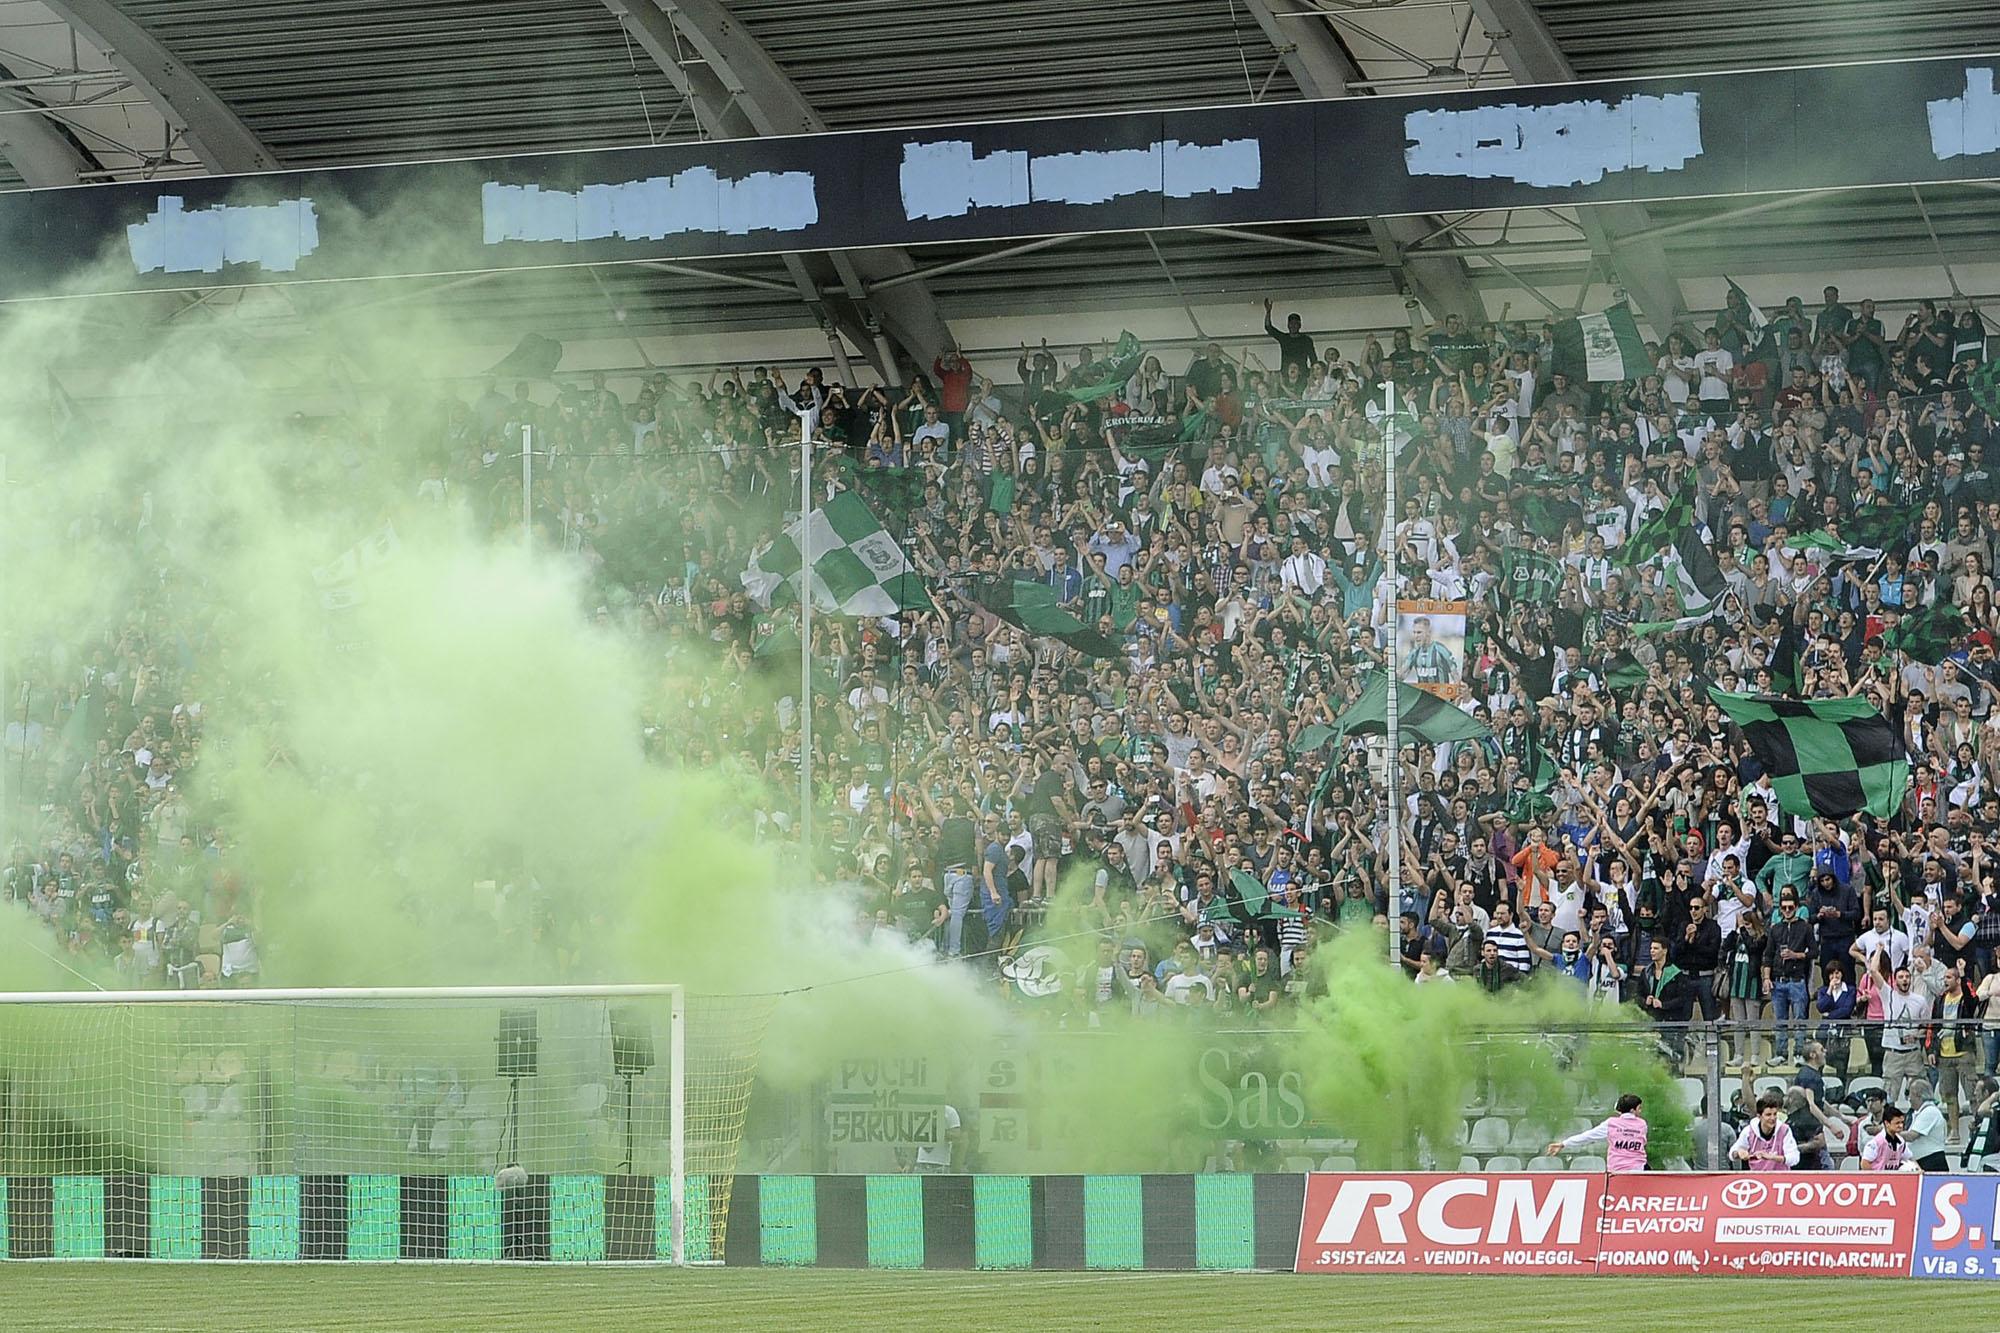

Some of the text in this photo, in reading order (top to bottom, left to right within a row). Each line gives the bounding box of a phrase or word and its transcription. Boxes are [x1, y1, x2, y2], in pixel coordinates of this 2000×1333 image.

[1598, 1194, 1709, 1212] CARRELLI
[1772, 1182, 1897, 1207] TOYOTA
[1315, 1178, 1588, 1245] RCM
[1595, 1216, 1705, 1234] ELEVATORI
[1722, 1224, 1888, 1237] INDUSTRIAL EQUIPMENT
[1312, 1250, 1406, 1265] SSISTENZA
[1598, 1251, 1669, 1265] FIORANO
[1923, 1257, 1957, 1274] Via
[1964, 1257, 1985, 1274] S.
